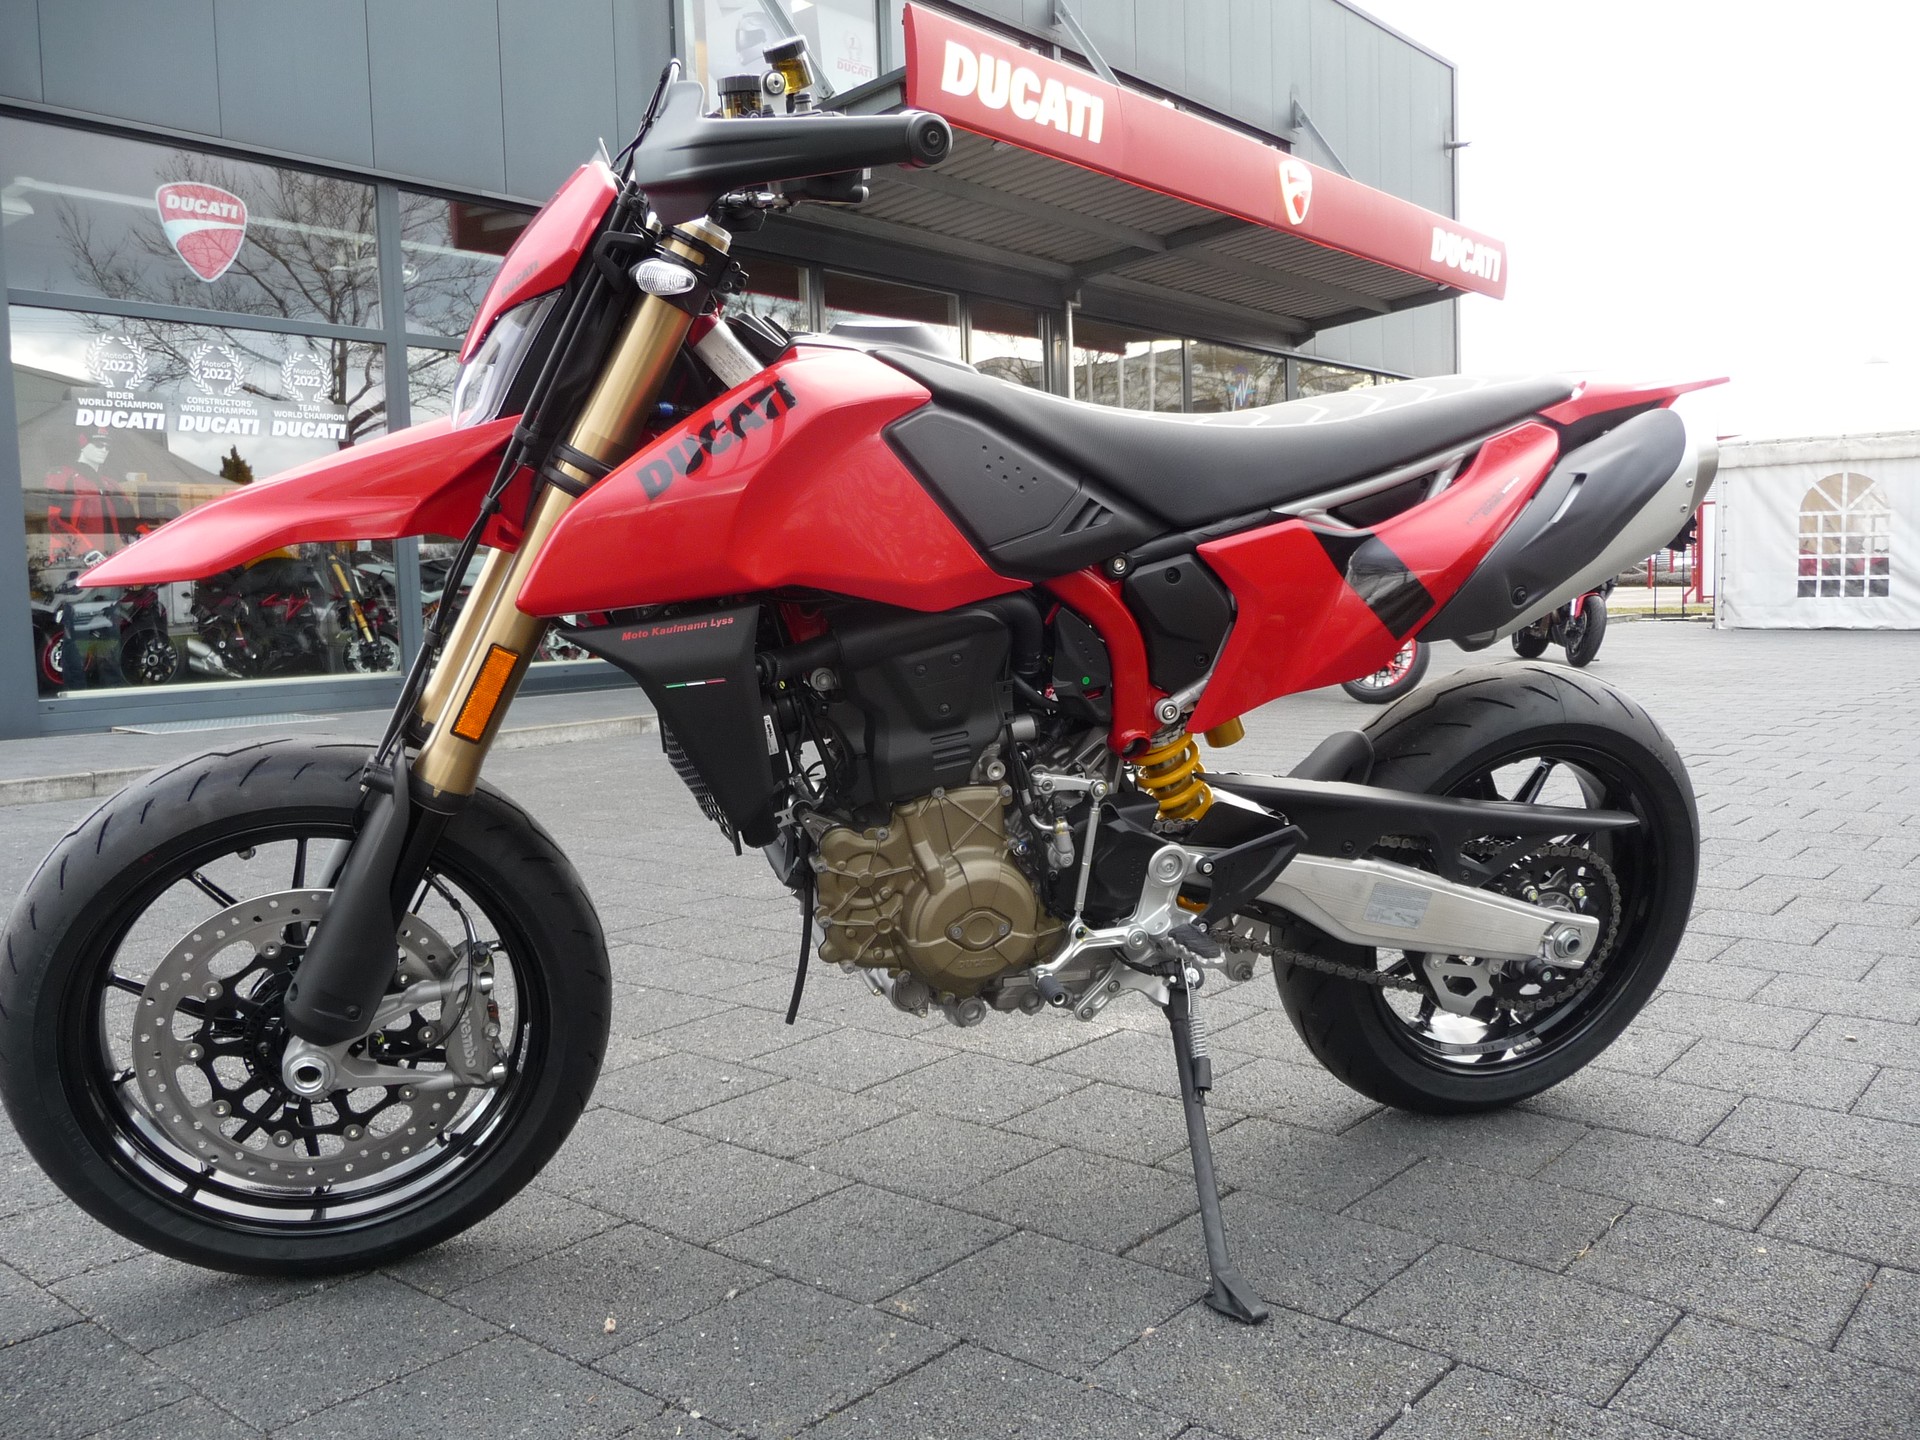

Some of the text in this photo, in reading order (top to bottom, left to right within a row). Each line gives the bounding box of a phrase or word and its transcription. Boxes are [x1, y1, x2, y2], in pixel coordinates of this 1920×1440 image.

[836, 60, 873, 79] DUCATI
[941, 39, 1104, 144] DUCATI
[166, 194, 239, 219] DUCATI
[1430, 226, 1502, 282] DUCATI
[101, 351, 134, 361] MotoGP
[102, 360, 135, 373] 2022
[201, 360, 232, 369] MotoGP
[202, 367, 233, 381] 2022
[293, 367, 320, 376] MotoGP
[293, 375, 322, 387] 2022
[106, 391, 135, 401] RIDER
[78, 398, 163, 411] WORLD CHAMPION
[180, 404, 258, 417] WORLD CHAMPION
[298, 404, 321, 413] TEAM
[76, 409, 165, 430] DUCATI
[274, 410, 345, 422] WORLD CHAMPION
[178, 415, 260, 435] DUCATI
[272, 421, 347, 440] DUCATI
[635, 377, 798, 502] DUCATI
[621, 617, 734, 641] Moto Kaufmann Lyss
